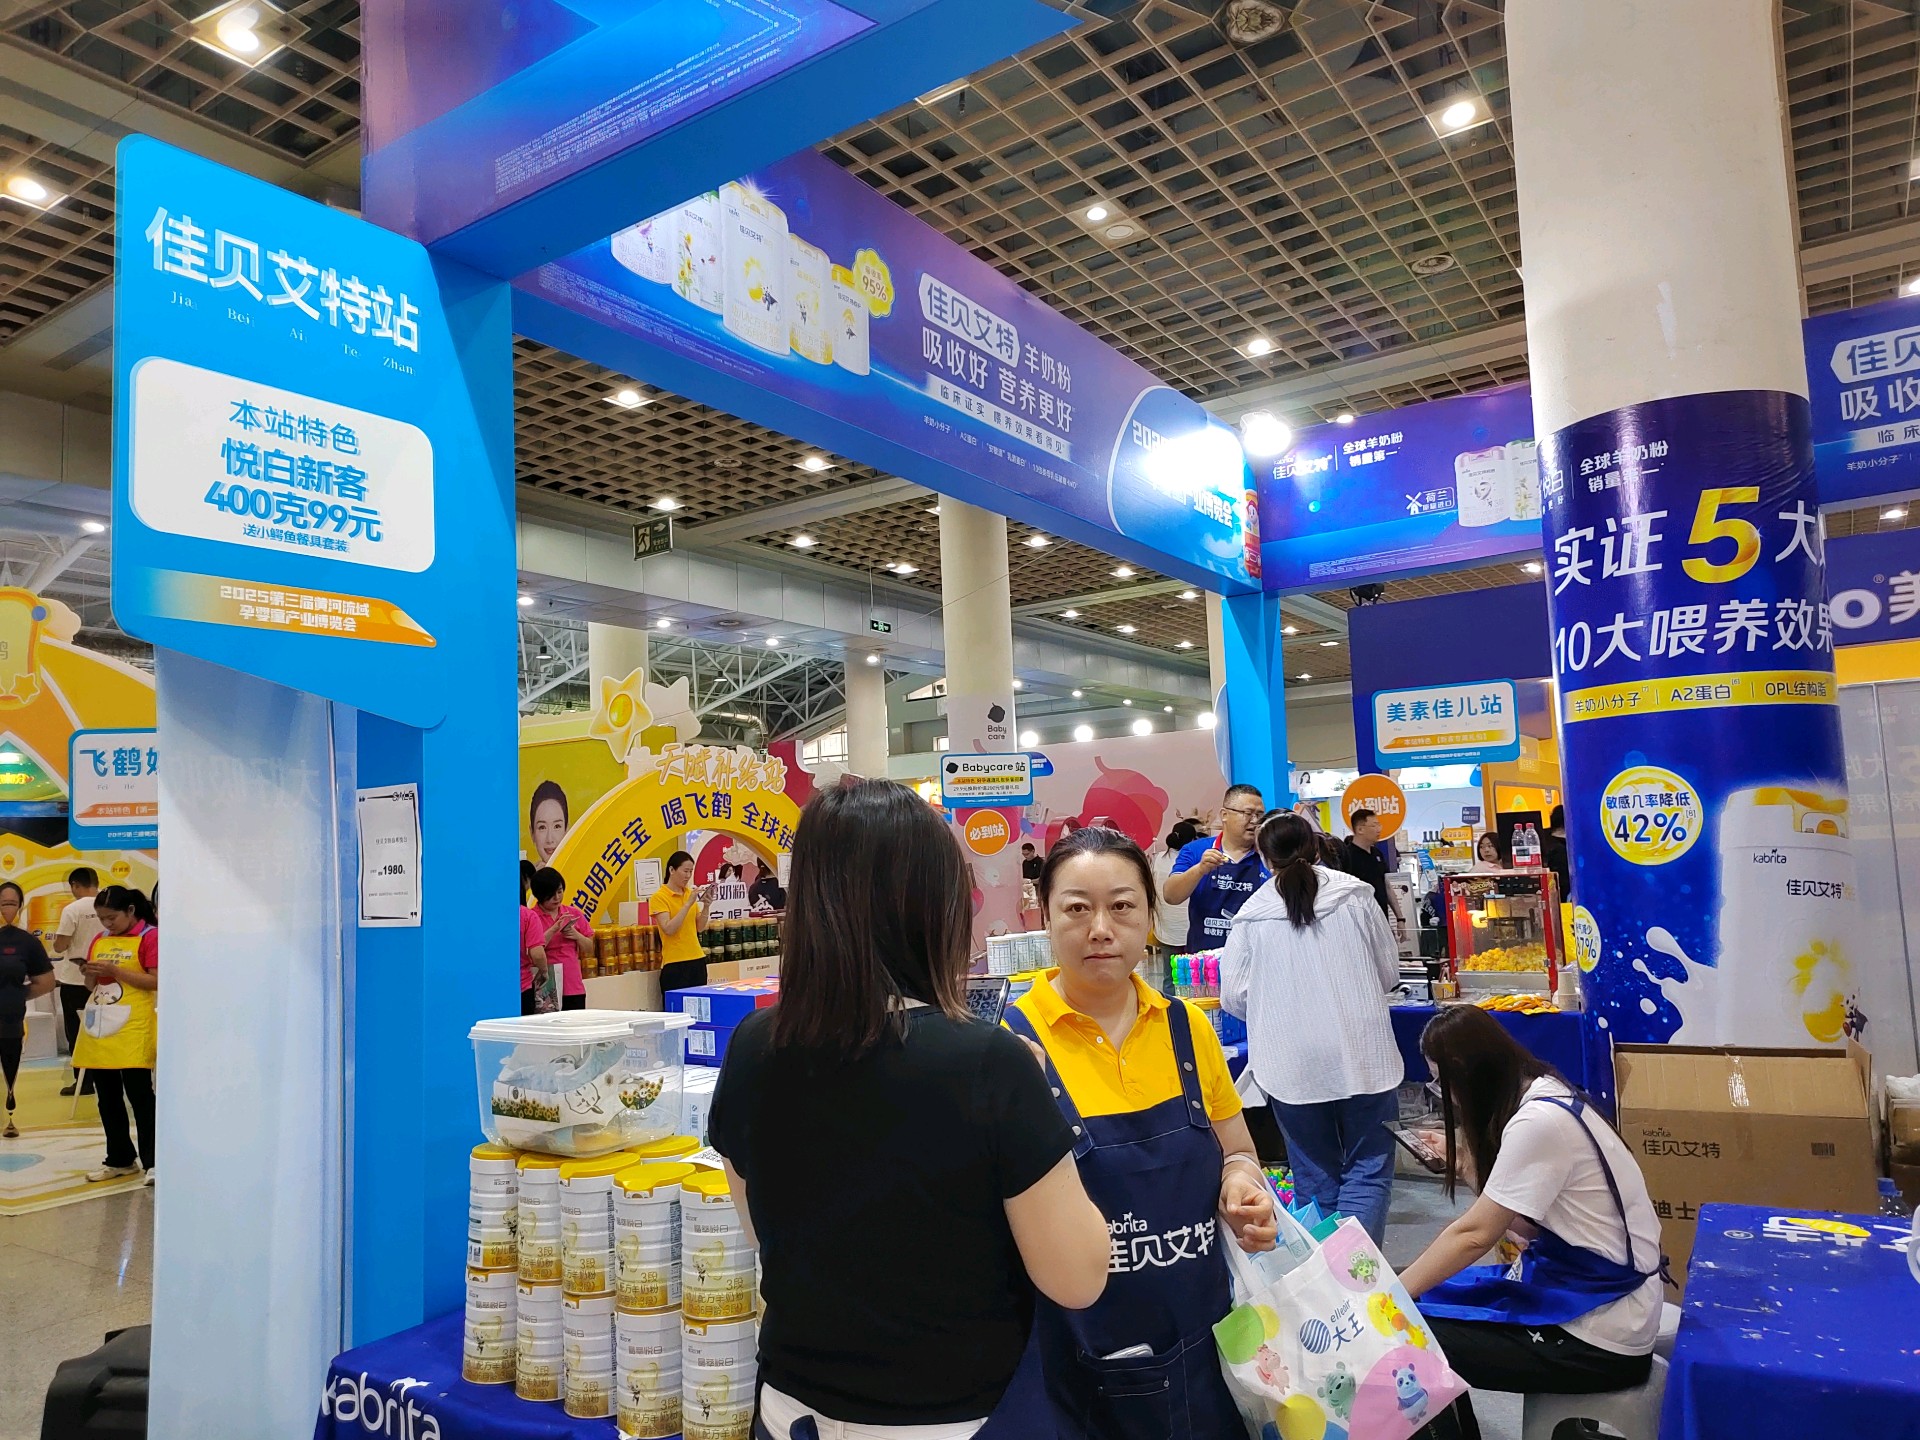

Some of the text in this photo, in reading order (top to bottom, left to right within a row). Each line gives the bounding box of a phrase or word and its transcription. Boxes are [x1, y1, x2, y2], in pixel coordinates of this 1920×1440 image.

[145, 206, 420, 353] 佳贝艾特站
[862, 274, 887, 301] 95%
[170, 291, 193, 308] Jia
[228, 307, 253, 327] Bei
[289, 326, 306, 342] Ai
[382, 355, 415, 376] Zhan
[927, 283, 1072, 394] 佳贝艾特 羊奶粉
[922, 326, 1073, 433] 吸收好 营养更好
[1839, 378, 1920, 422] 吸收
[229, 399, 359, 456] 本站特色
[940, 384, 985, 417] 临床证实
[993, 411, 1063, 454] 喂养效果看得见
[923, 414, 951, 434] 羊奶小分子
[959, 433, 977, 447] A2蛋白
[1878, 424, 1920, 445] 临床
[1343, 431, 1404, 455] 全球羊奶粉
[1349, 449, 1398, 468] 销量第一
[1579, 439, 1669, 476] 全球羊奶粉
[1846, 454, 1901, 472] 羊奶小分子
[220, 437, 367, 501] 悦白新客
[1587, 465, 1661, 494] 销量第一
[1425, 489, 1449, 504] 荷兰
[203, 482, 382, 542] 400克99元
[243, 523, 349, 553] 送小鳄鱼餐具套装
[1554, 510, 1669, 597] 实证
[1681, 486, 1762, 584] 5
[1775, 500, 1820, 564] 大
[220, 586, 370, 618] 2025第三届黄河流域
[239, 604, 357, 633] 孕婴童产业博览会
[1555, 597, 1834, 675] 10大喂养效果
[1670, 684, 1731, 702] A2蛋白
[1765, 680, 1828, 698] OPL结构脂
[1386, 693, 1503, 724] 美素佳儿站
[1574, 690, 1642, 714] 羊奶小分子
[987, 725, 1007, 734] Baby
[655, 745, 785, 793] 天赋补给站
[962, 763, 1014, 774] Babycare
[1015, 761, 1026, 772] 站
[97, 805, 131, 815] 本站特色
[1348, 794, 1400, 817] 必到站
[1605, 791, 1691, 810] 敏感几率降低
[660, 791, 795, 852] 喝飞鹤 全球销
[970, 823, 1006, 841] 必到站
[1614, 812, 1687, 843] 42%
[1753, 850, 1787, 864] kabrita
[383, 864, 403, 876] 1980
[1217, 880, 1254, 892] 佳贝艾特
[1786, 878, 1842, 900] 佳贝艾特
[1205, 918, 1232, 928] 佳贝艾特
[1642, 1128, 1672, 1137] kabrita
[1642, 1139, 1721, 1159] 佳贝艾特
[537, 1246, 554, 1258] 3段
[1107, 1218, 1216, 1273] 佳贝艾特
[579, 1257, 596, 1270] 3段
[640, 1271, 658, 1284] 3段
[726, 1277, 744, 1291] 3段
[685, 1293, 744, 1304] 幼儿配方羊奶粉
[1332, 1315, 1365, 1351] 大王
[534, 1365, 549, 1377] 3段
[582, 1381, 600, 1393] 3段
[321, 1371, 441, 1440] kabrita
[660, 1396, 678, 1411] 3段
[619, 1411, 678, 1424] 幼儿配方羊奶粉
[731, 1411, 749, 1426] 3段
